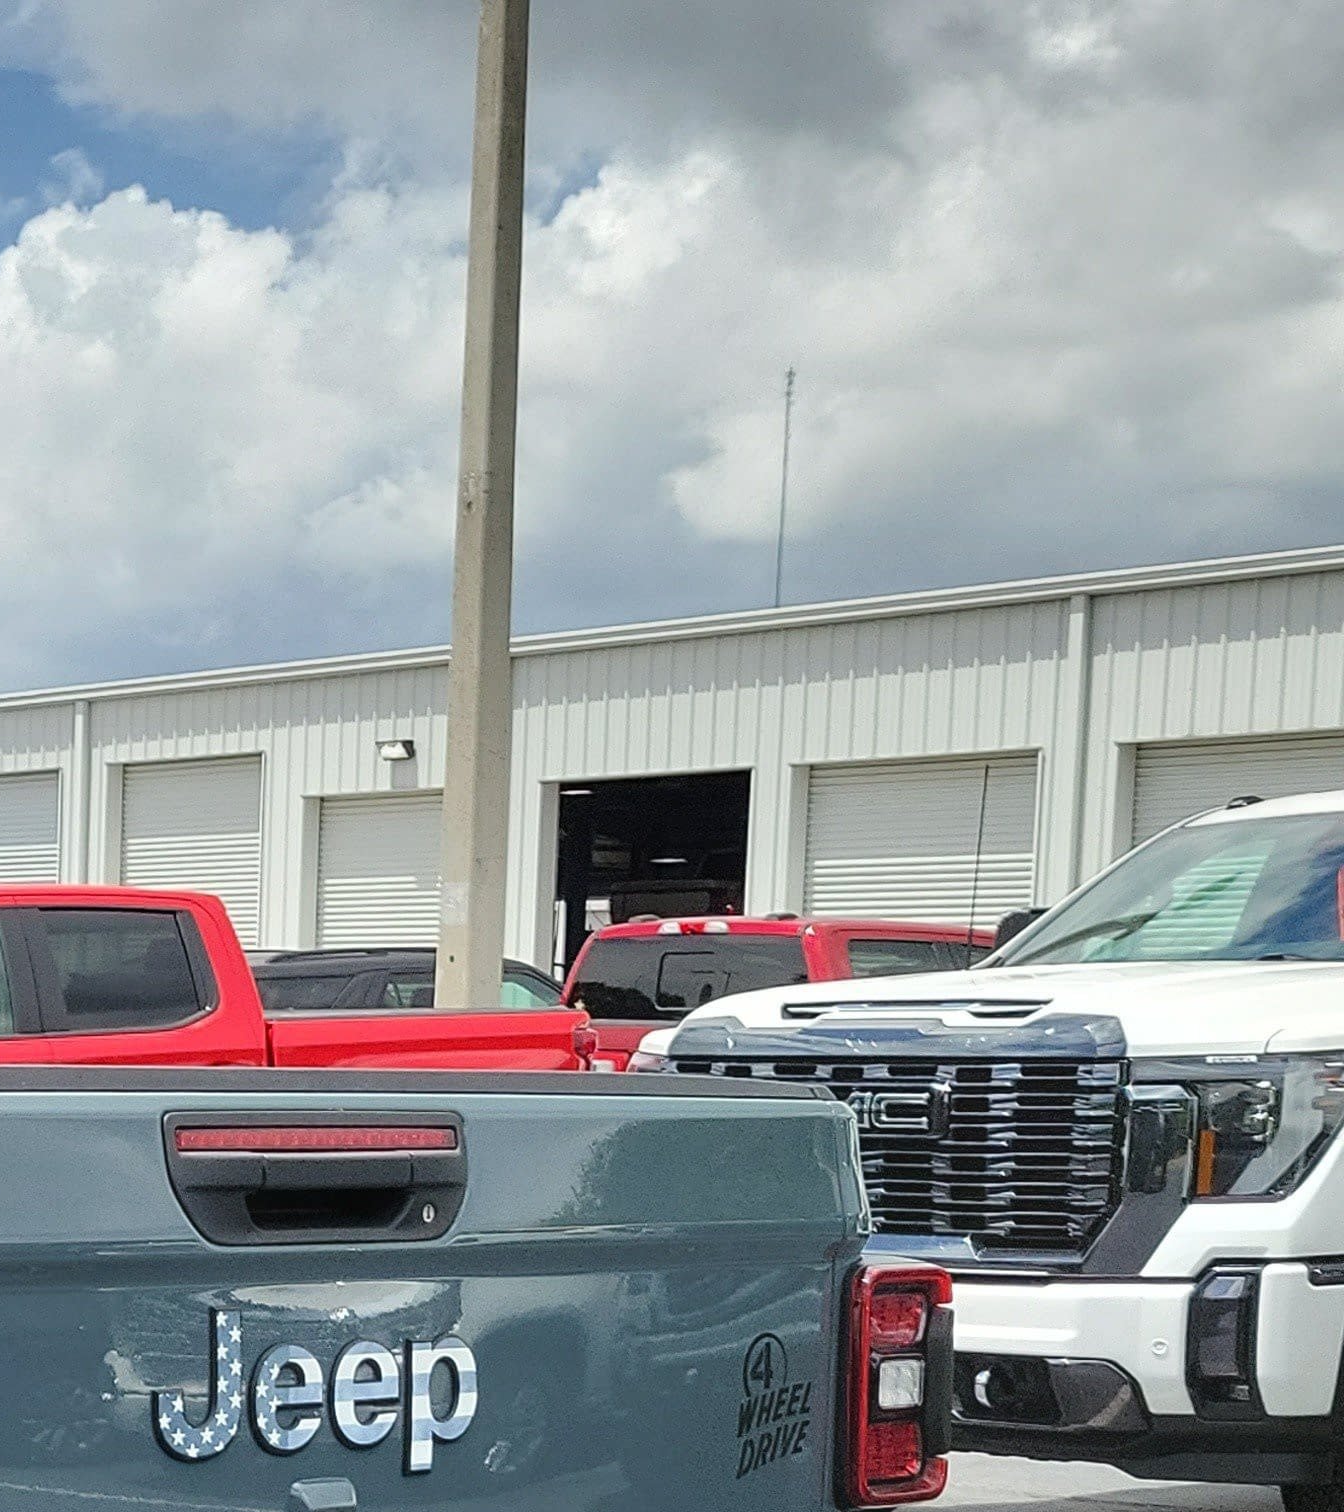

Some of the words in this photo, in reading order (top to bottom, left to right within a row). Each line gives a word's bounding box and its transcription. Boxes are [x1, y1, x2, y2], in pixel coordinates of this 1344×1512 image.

[153, 1308, 478, 1475] Jeep
[737, 1382, 811, 1438] WHEEL
[736, 1420, 810, 1479] DRIVE
